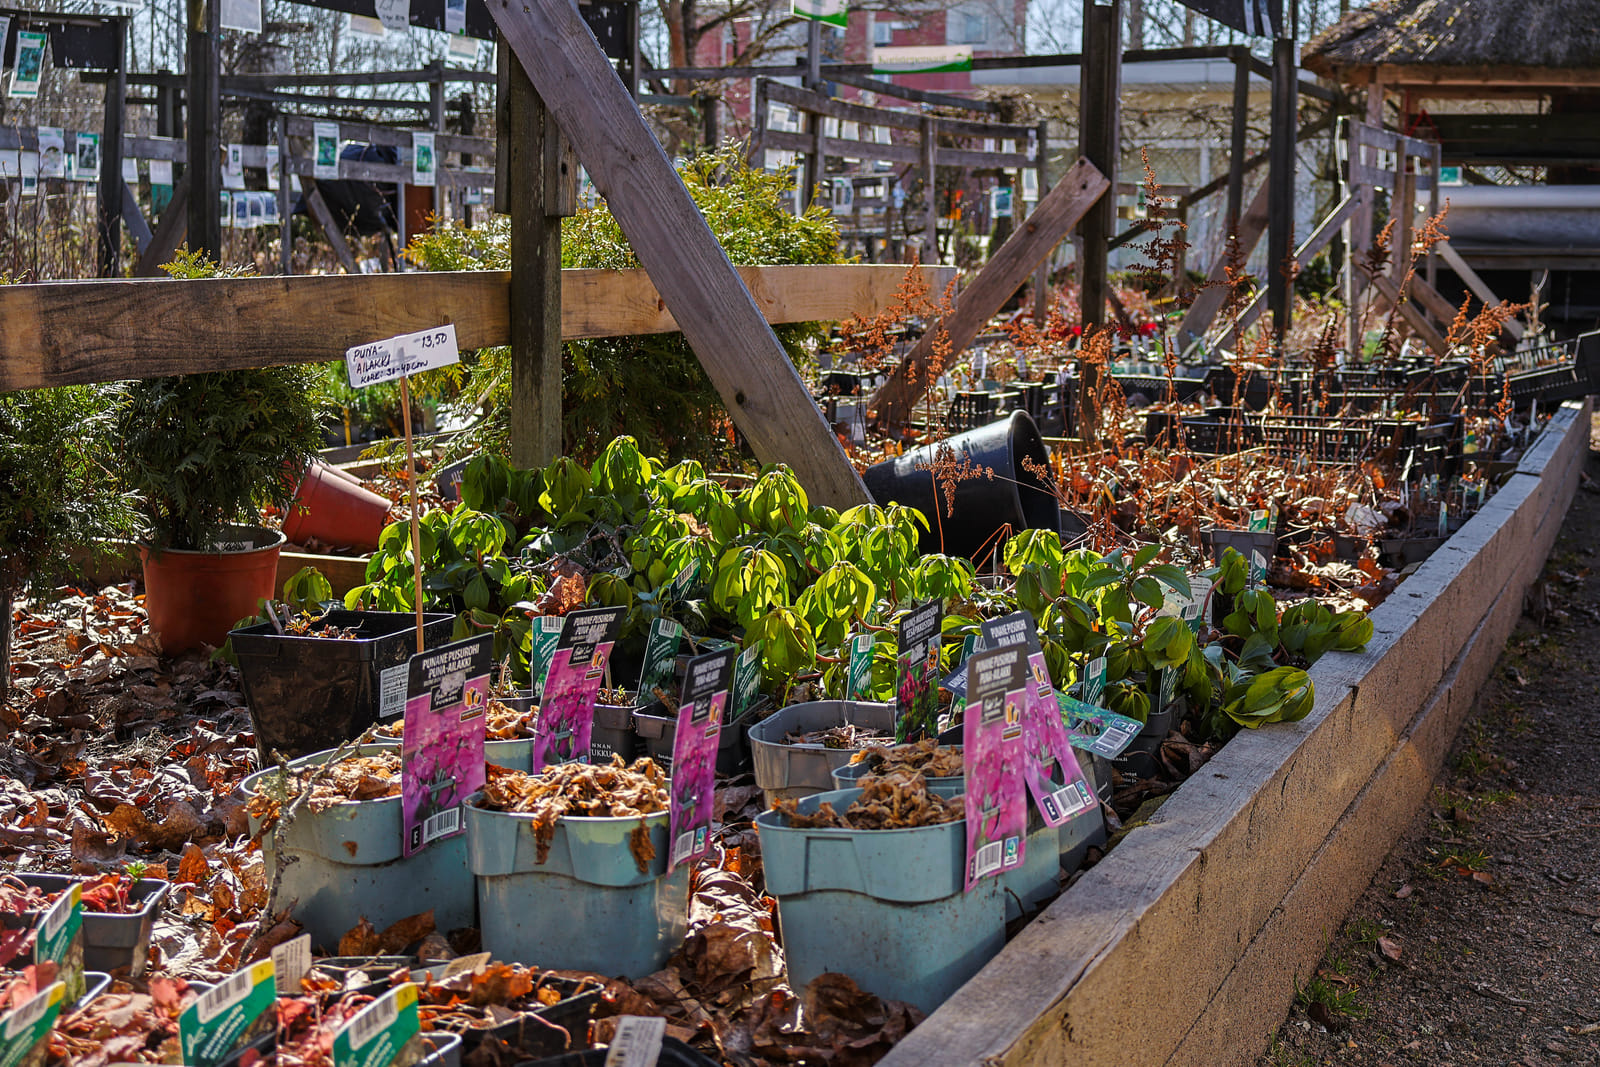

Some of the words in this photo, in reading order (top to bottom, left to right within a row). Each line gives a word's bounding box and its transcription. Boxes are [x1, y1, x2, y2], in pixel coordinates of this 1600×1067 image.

[422, 332, 447, 348] 13,50
[353, 345, 383, 362] PUNA-
[356, 354, 391, 374] AILAKKI
[422, 653, 448, 671] PUNANE
[448, 643, 480, 662] PUSUROHI
[428, 656, 472, 679] PUNA-AILAKKI
